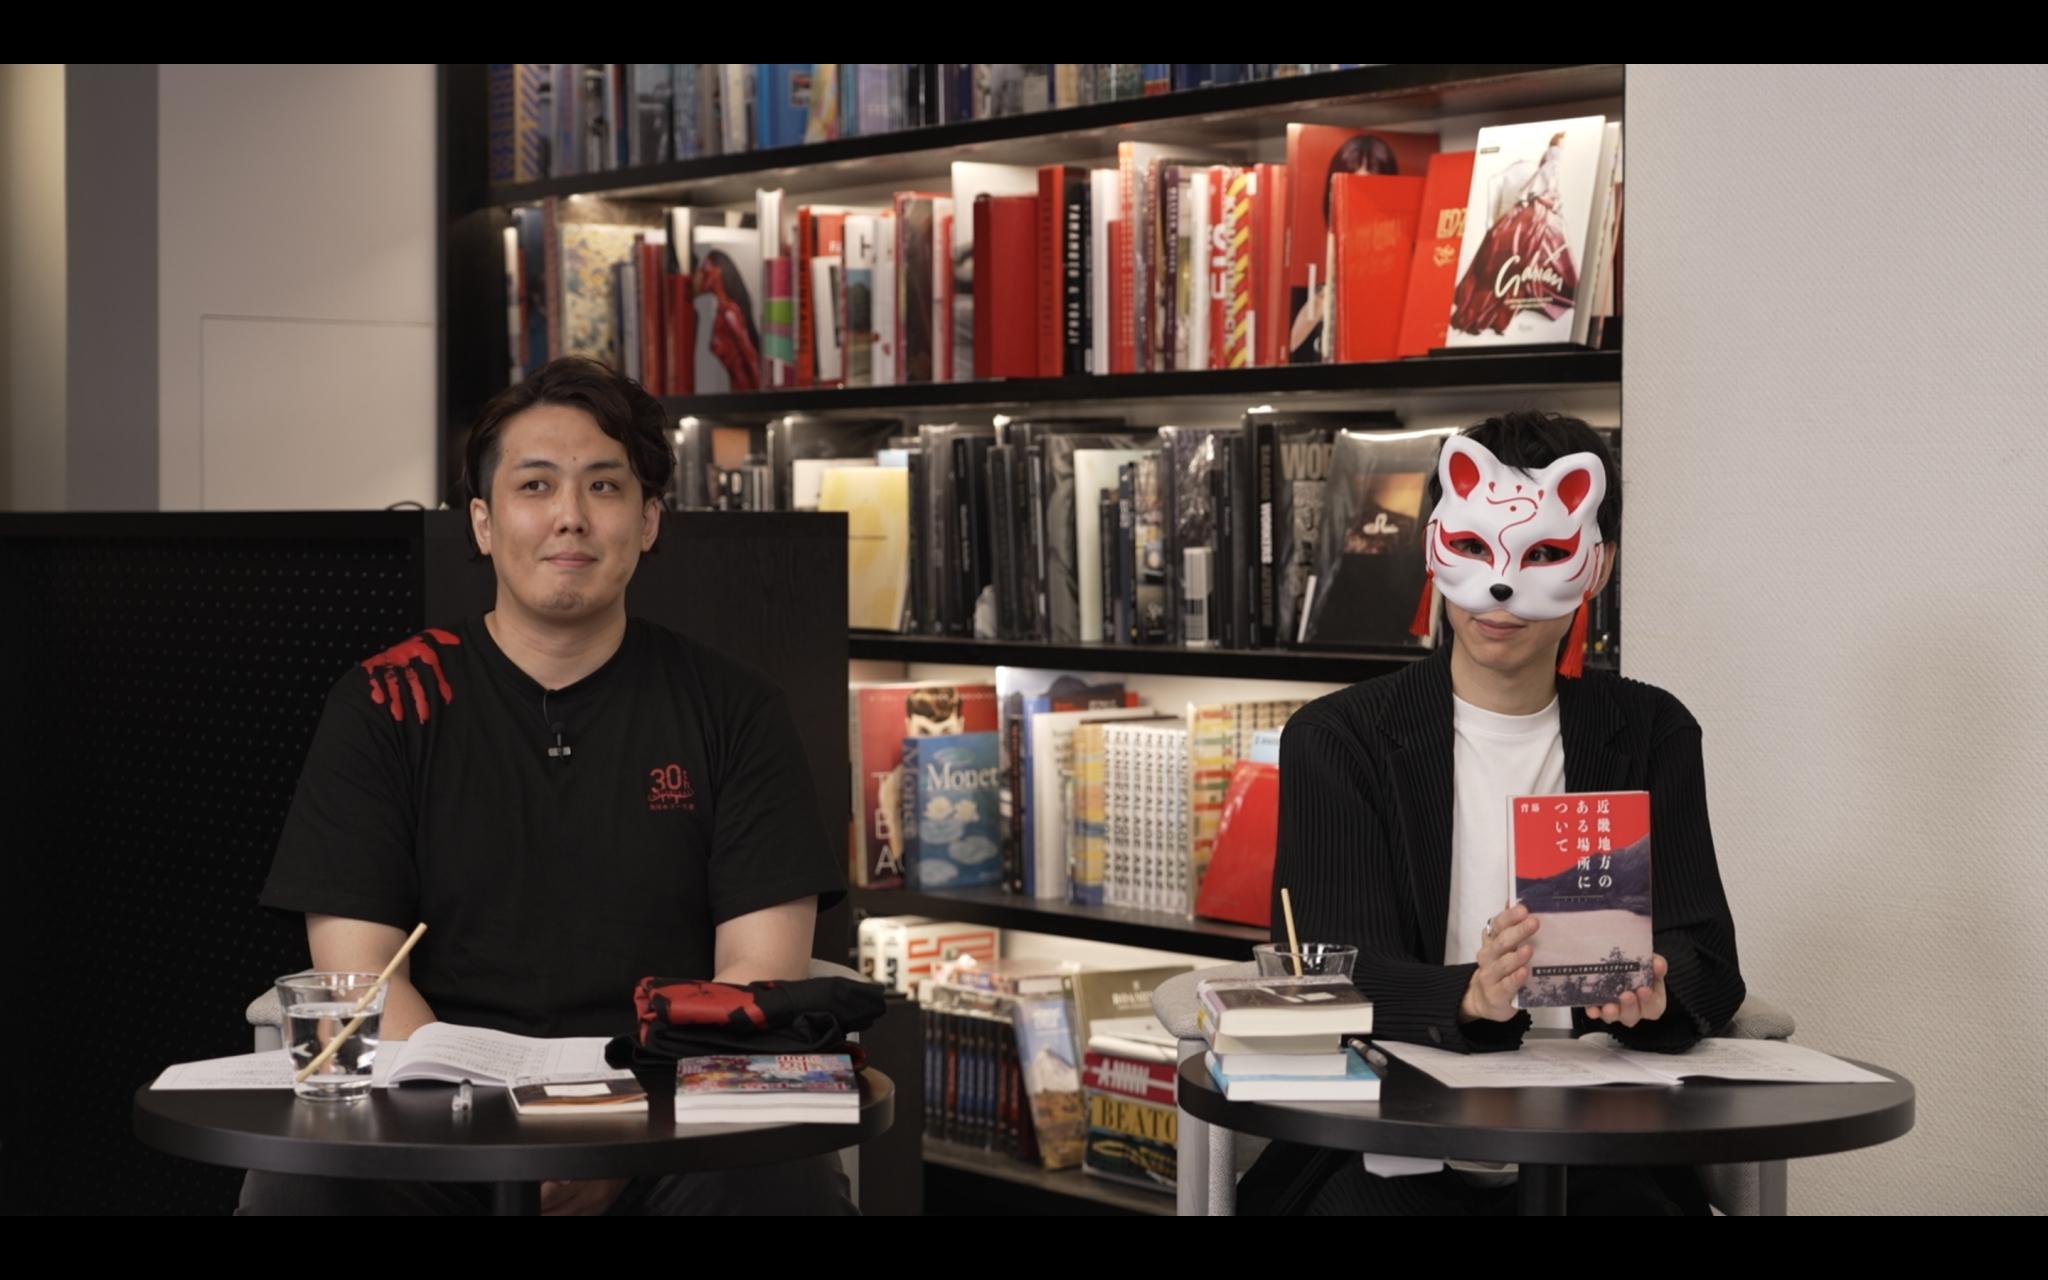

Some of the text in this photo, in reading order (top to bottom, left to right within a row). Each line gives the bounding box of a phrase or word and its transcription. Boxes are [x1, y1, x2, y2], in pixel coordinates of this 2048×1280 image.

[927, 761, 999, 793] Monet
[1554, 802, 1569, 853] ついて
[1576, 800, 1592, 889] ある場所に
[1597, 799, 1613, 888] 近畿地方の
